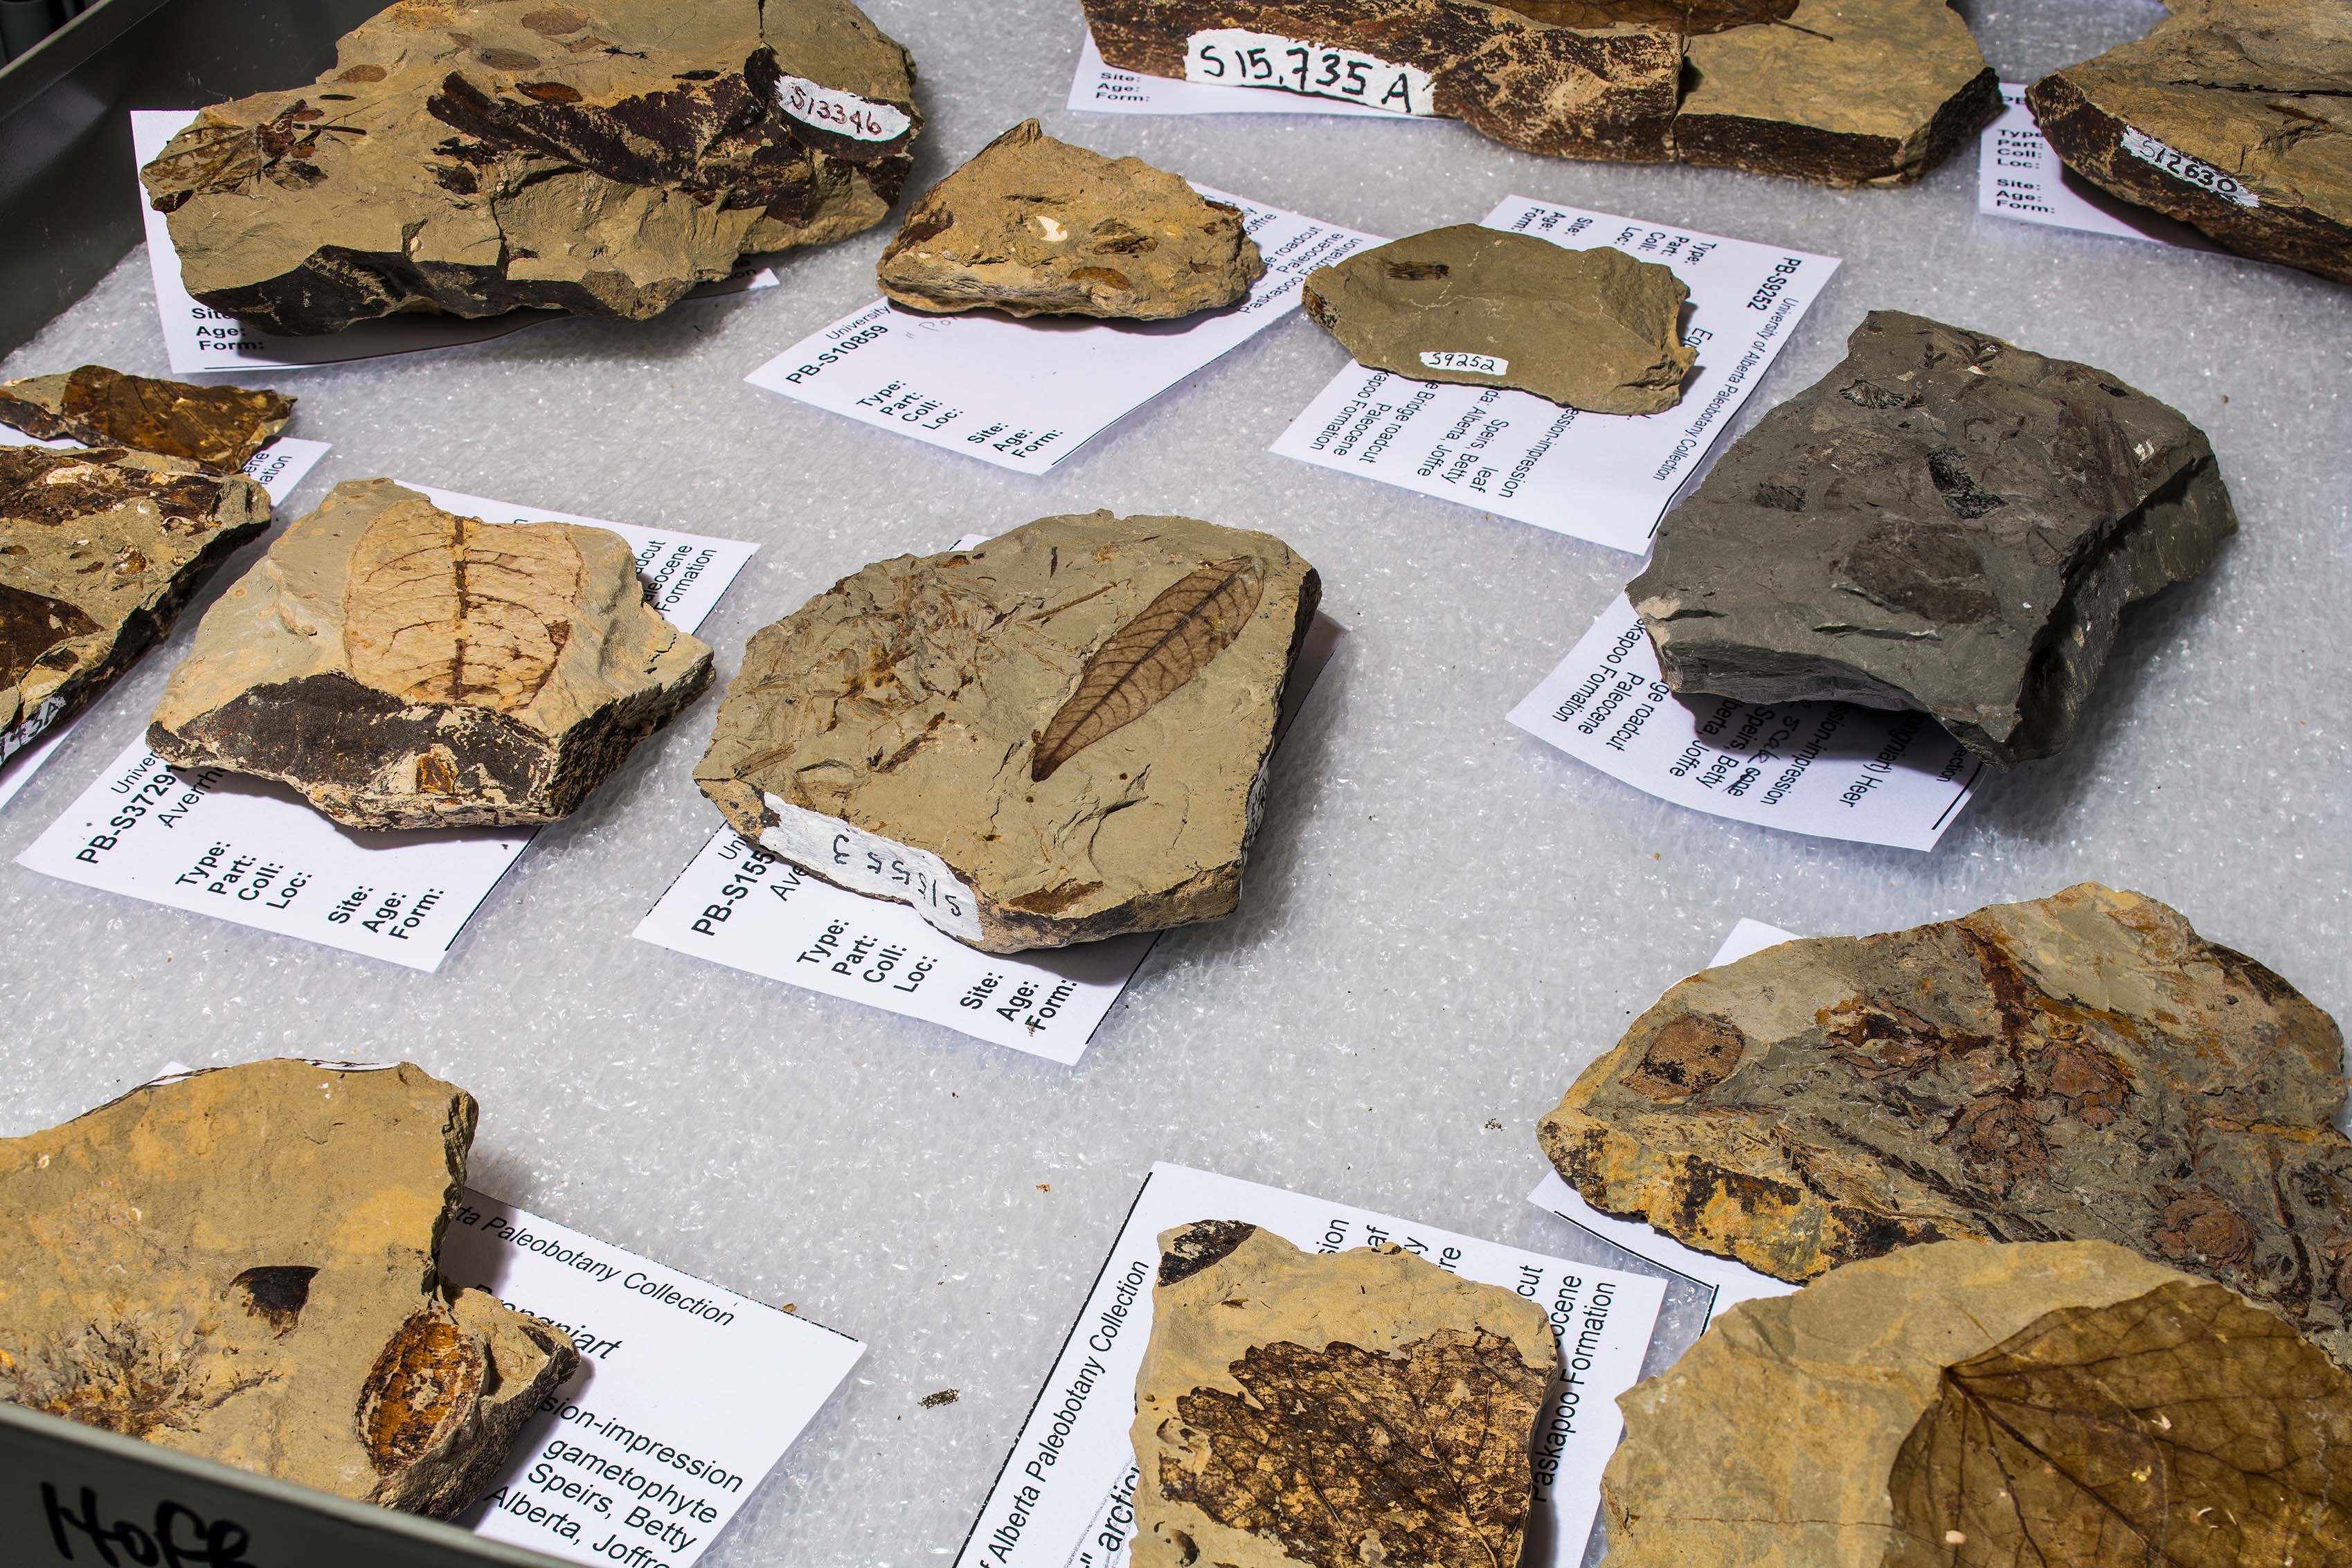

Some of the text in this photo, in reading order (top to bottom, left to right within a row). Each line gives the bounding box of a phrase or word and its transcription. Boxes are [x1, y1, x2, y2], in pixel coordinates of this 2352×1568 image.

[1096, 91, 1151, 102] Form:
[1098, 82, 1140, 92] Age:
[1101, 72, 1141, 82] Site:
[790, 85, 882, 135] S13346
[1997, 148, 2042, 159] Coll:
[1997, 158, 2040, 169] Loc:
[1998, 138, 2043, 150] Part:
[1997, 178, 2040, 191] Site:
[2139, 139, 2238, 193] S12630
[1996, 190, 2042, 202] Age:
[1997, 199, 2056, 214] Form:
[1246, 213, 1277, 236] offre
[1510, 206, 1546, 233] Form:
[1614, 226, 1643, 246] Loc:
[1275, 226, 1324, 257] roadcut
[1276, 233, 1345, 273] Paleocene
[1684, 241, 1718, 265] Type:
[1237, 276, 1304, 314] Paskapoo
[1746, 257, 1803, 311] PB-S9252
[196, 325, 246, 339] Age:
[825, 304, 892, 341] University
[1333, 210, 1568, 456] Age: Paleocene
[1358, 216, 1593, 464] Site: Bridge roadcut
[199, 340, 264, 351] Form:
[784, 325, 889, 384] PB-S10859
[1428, 352, 1496, 372] S9252
[1440, 231, 1666, 485] Coll: Speirs, Betty
[1469, 235, 1690, 494] Part: leaf
[856, 379, 906, 407] Type:
[879, 392, 924, 416] Part:
[1652, 297, 1800, 481] University of Alberta Paleobotany Collection
[901, 400, 944, 422] Coll:
[922, 408, 964, 430] Loc:
[1309, 399, 1368, 451] Formation
[1439, 406, 1487, 442] Alberta,
[967, 422, 1009, 444] Site:
[991, 429, 1034, 453] Age:
[1011, 429, 1064, 458] Form:
[259, 455, 293, 485] ation
[1417, 444, 1453, 477] Joffre
[641, 545, 693, 602] aleocene
[652, 548, 717, 612] Formation
[1552, 664, 1618, 722] Formation
[1577, 671, 1646, 735] Paleocene
[1606, 703, 1655, 753] roadcut
[1669, 739, 1710, 777] Joffre
[1696, 707, 1776, 790] Speirs, Betty
[1838, 774, 1883, 809] Heer
[75, 764, 188, 865] PB-S37291
[174, 840, 232, 885] Type:
[207, 854, 257, 895] Part:
[237, 863, 285, 901] Coll:
[264, 872, 313, 910] Loc:
[327, 885, 375, 925] Site:
[691, 845, 777, 936] PB-S155
[361, 891, 408, 934] Age:
[388, 887, 445, 940] Form:
[796, 919, 850, 964] Type:
[830, 935, 879, 977] Part:
[862, 944, 908, 983] Coll:
[892, 955, 938, 993] Loc:
[960, 971, 1004, 1011] Site:
[995, 980, 1040, 1022] Age:
[1024, 979, 1078, 1031] Form:
[481, 1216, 622, 1283] Paleobotany
[623, 1272, 736, 1327] Collection
[1560, 1281, 1617, 1385] Formation
[987, 1260, 1149, 1565] Alberta Paleobotany Collection
[542, 1439, 718, 1524] gametophyte
[483, 1485, 582, 1547] Alberta,
[528, 1462, 698, 1554] Speirs, Betty
[1097, 1466, 1140, 1552] arctic
